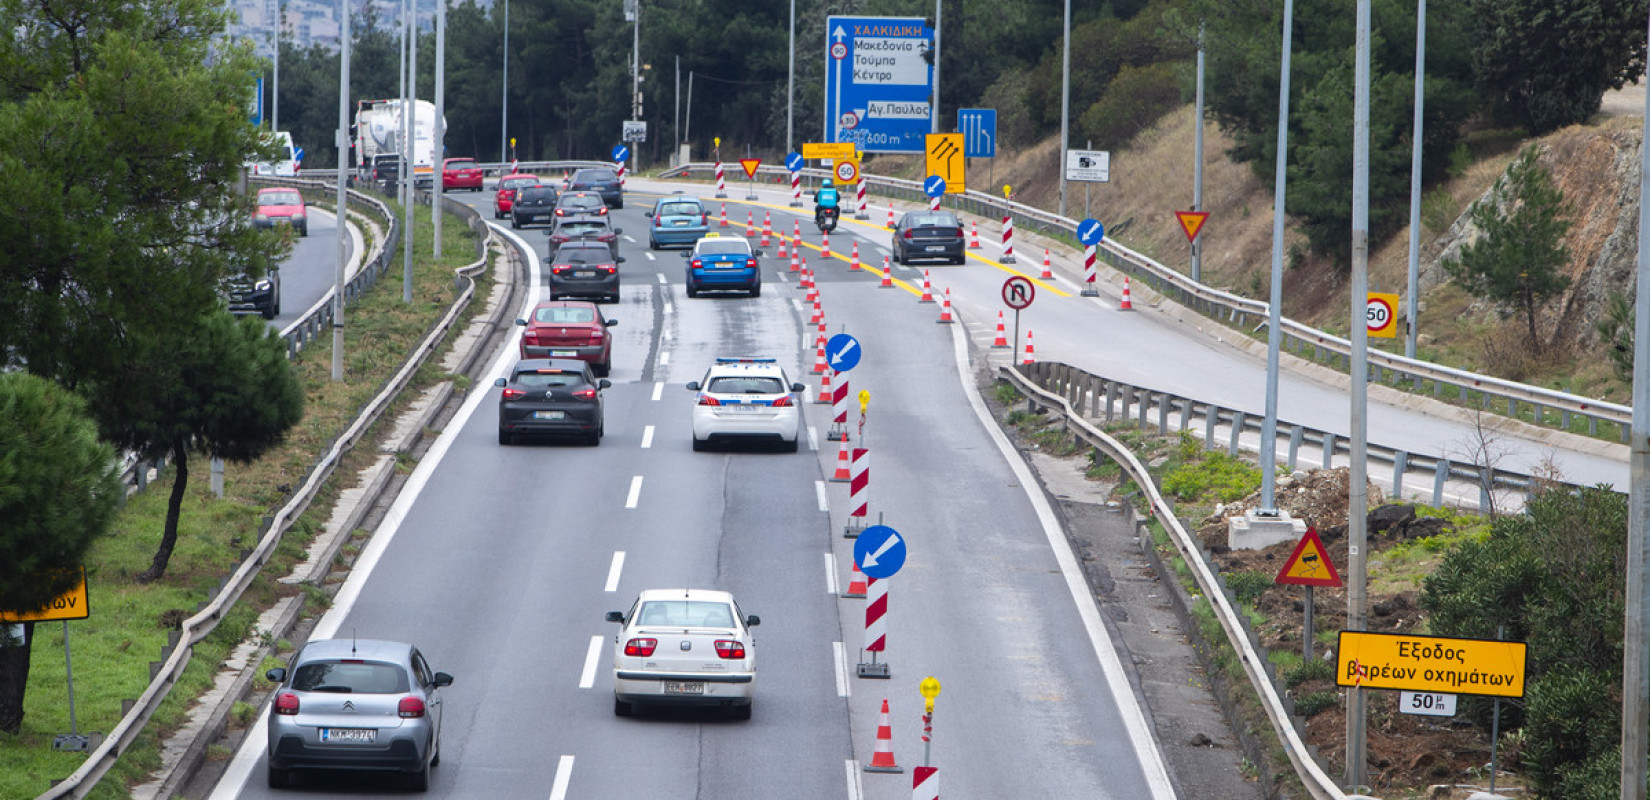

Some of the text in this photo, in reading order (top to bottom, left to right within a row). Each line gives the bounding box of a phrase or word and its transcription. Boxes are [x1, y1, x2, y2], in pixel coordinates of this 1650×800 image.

[854, 25, 922, 37] ΧΑΛΚΙΔΙΚΗ
[834, 47, 845, 55] 90
[854, 40, 912, 51] Μακεδονία
[855, 54, 896, 67] Τούμπα
[853, 69, 892, 82] Κέντρο
[867, 133, 887, 144] 600
[889, 136, 900, 144] m
[841, 167, 852, 177] 50
[1366, 307, 1386, 322] 50
[1396, 641, 1466, 664] Έξοδος
[1424, 668, 1515, 687] οχημάτων
[1412, 693, 1433, 709] 50
